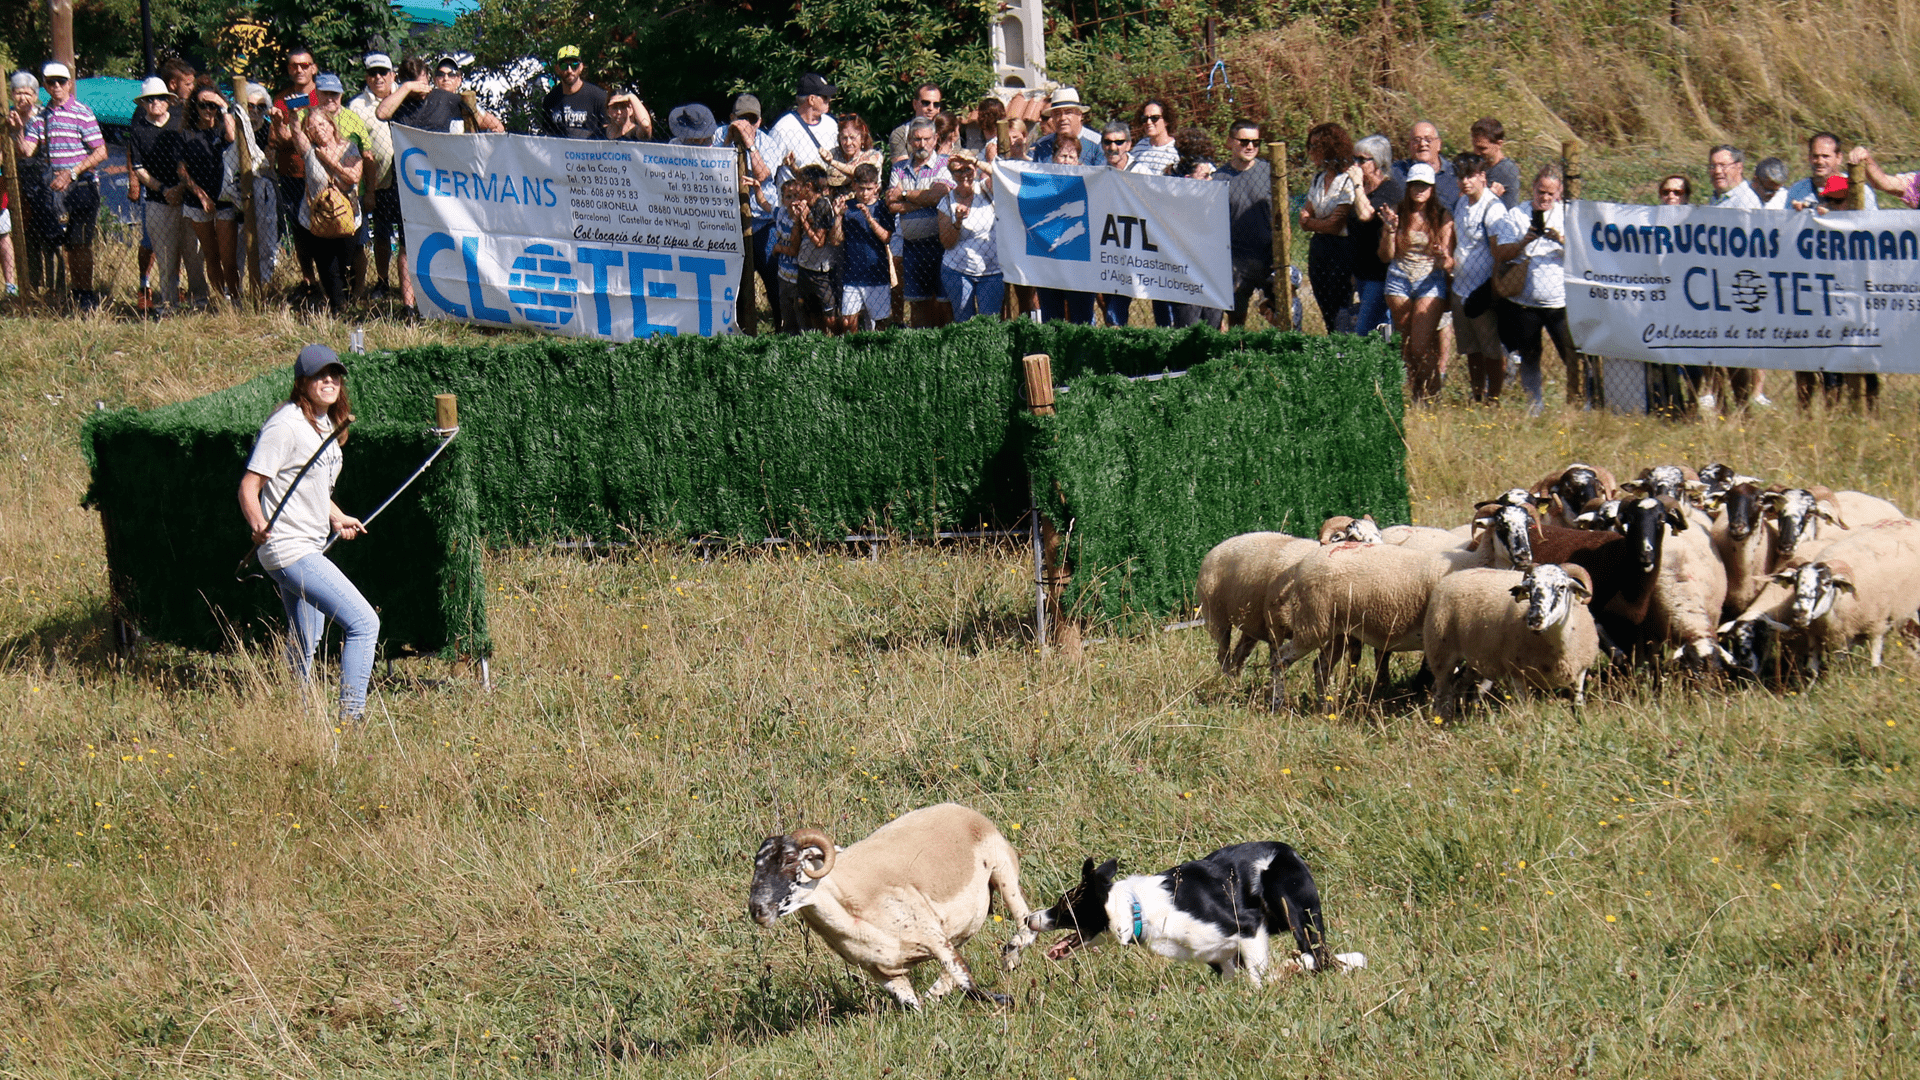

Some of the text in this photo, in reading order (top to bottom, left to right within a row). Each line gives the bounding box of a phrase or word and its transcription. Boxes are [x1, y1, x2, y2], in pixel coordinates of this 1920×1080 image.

[565, 151, 632, 162] CONSTRUCCIONS
[643, 155, 731, 169] EXCAVACIONS CLOTET
[566, 163, 627, 175] C/ de la Costa, 9
[650, 169, 666, 180] puig
[668, 169, 689, 182] d'Alp,
[400, 147, 557, 207] GERMANS
[567, 175, 631, 187] Tel. 93 825 03 28
[570, 187, 638, 200] Mob. 608 69 95 83
[668, 182, 732, 194] Tel. 93 825 16 64
[571, 199, 638, 212] 08680 GIRONELLA
[664, 195, 734, 207] Mob. 689 09 53 39
[648, 204, 735, 219] 08680 VILADOMIU VELL
[572, 211, 736, 233] (Barcelona) (Castellar de N'Hug) (Gironella)
[1100, 213, 1158, 253] ATL
[632, 231, 643, 244] de
[645, 233, 660, 245] tot
[662, 235, 689, 249] tipus
[692, 237, 705, 249] de
[707, 238, 737, 252] pedra
[1591, 221, 1918, 260] CONTRUCCIONS GERMAN
[1100, 252, 1188, 274] Ens d'Abastament
[1583, 270, 1671, 284] Construccions
[1136, 274, 1204, 295] Ter-Llobregat
[1613, 289, 1627, 301] 69
[1631, 290, 1646, 301] 95
[1650, 290, 1666, 301] 83
[1865, 298, 1887, 310] 689
[1890, 298, 1904, 311] 09
[1724, 324, 1740, 339] de
[1746, 327, 1766, 339] tot
[1773, 327, 1809, 343] tipus
[1816, 325, 1831, 339] de
[1840, 323, 1879, 341] pedra
